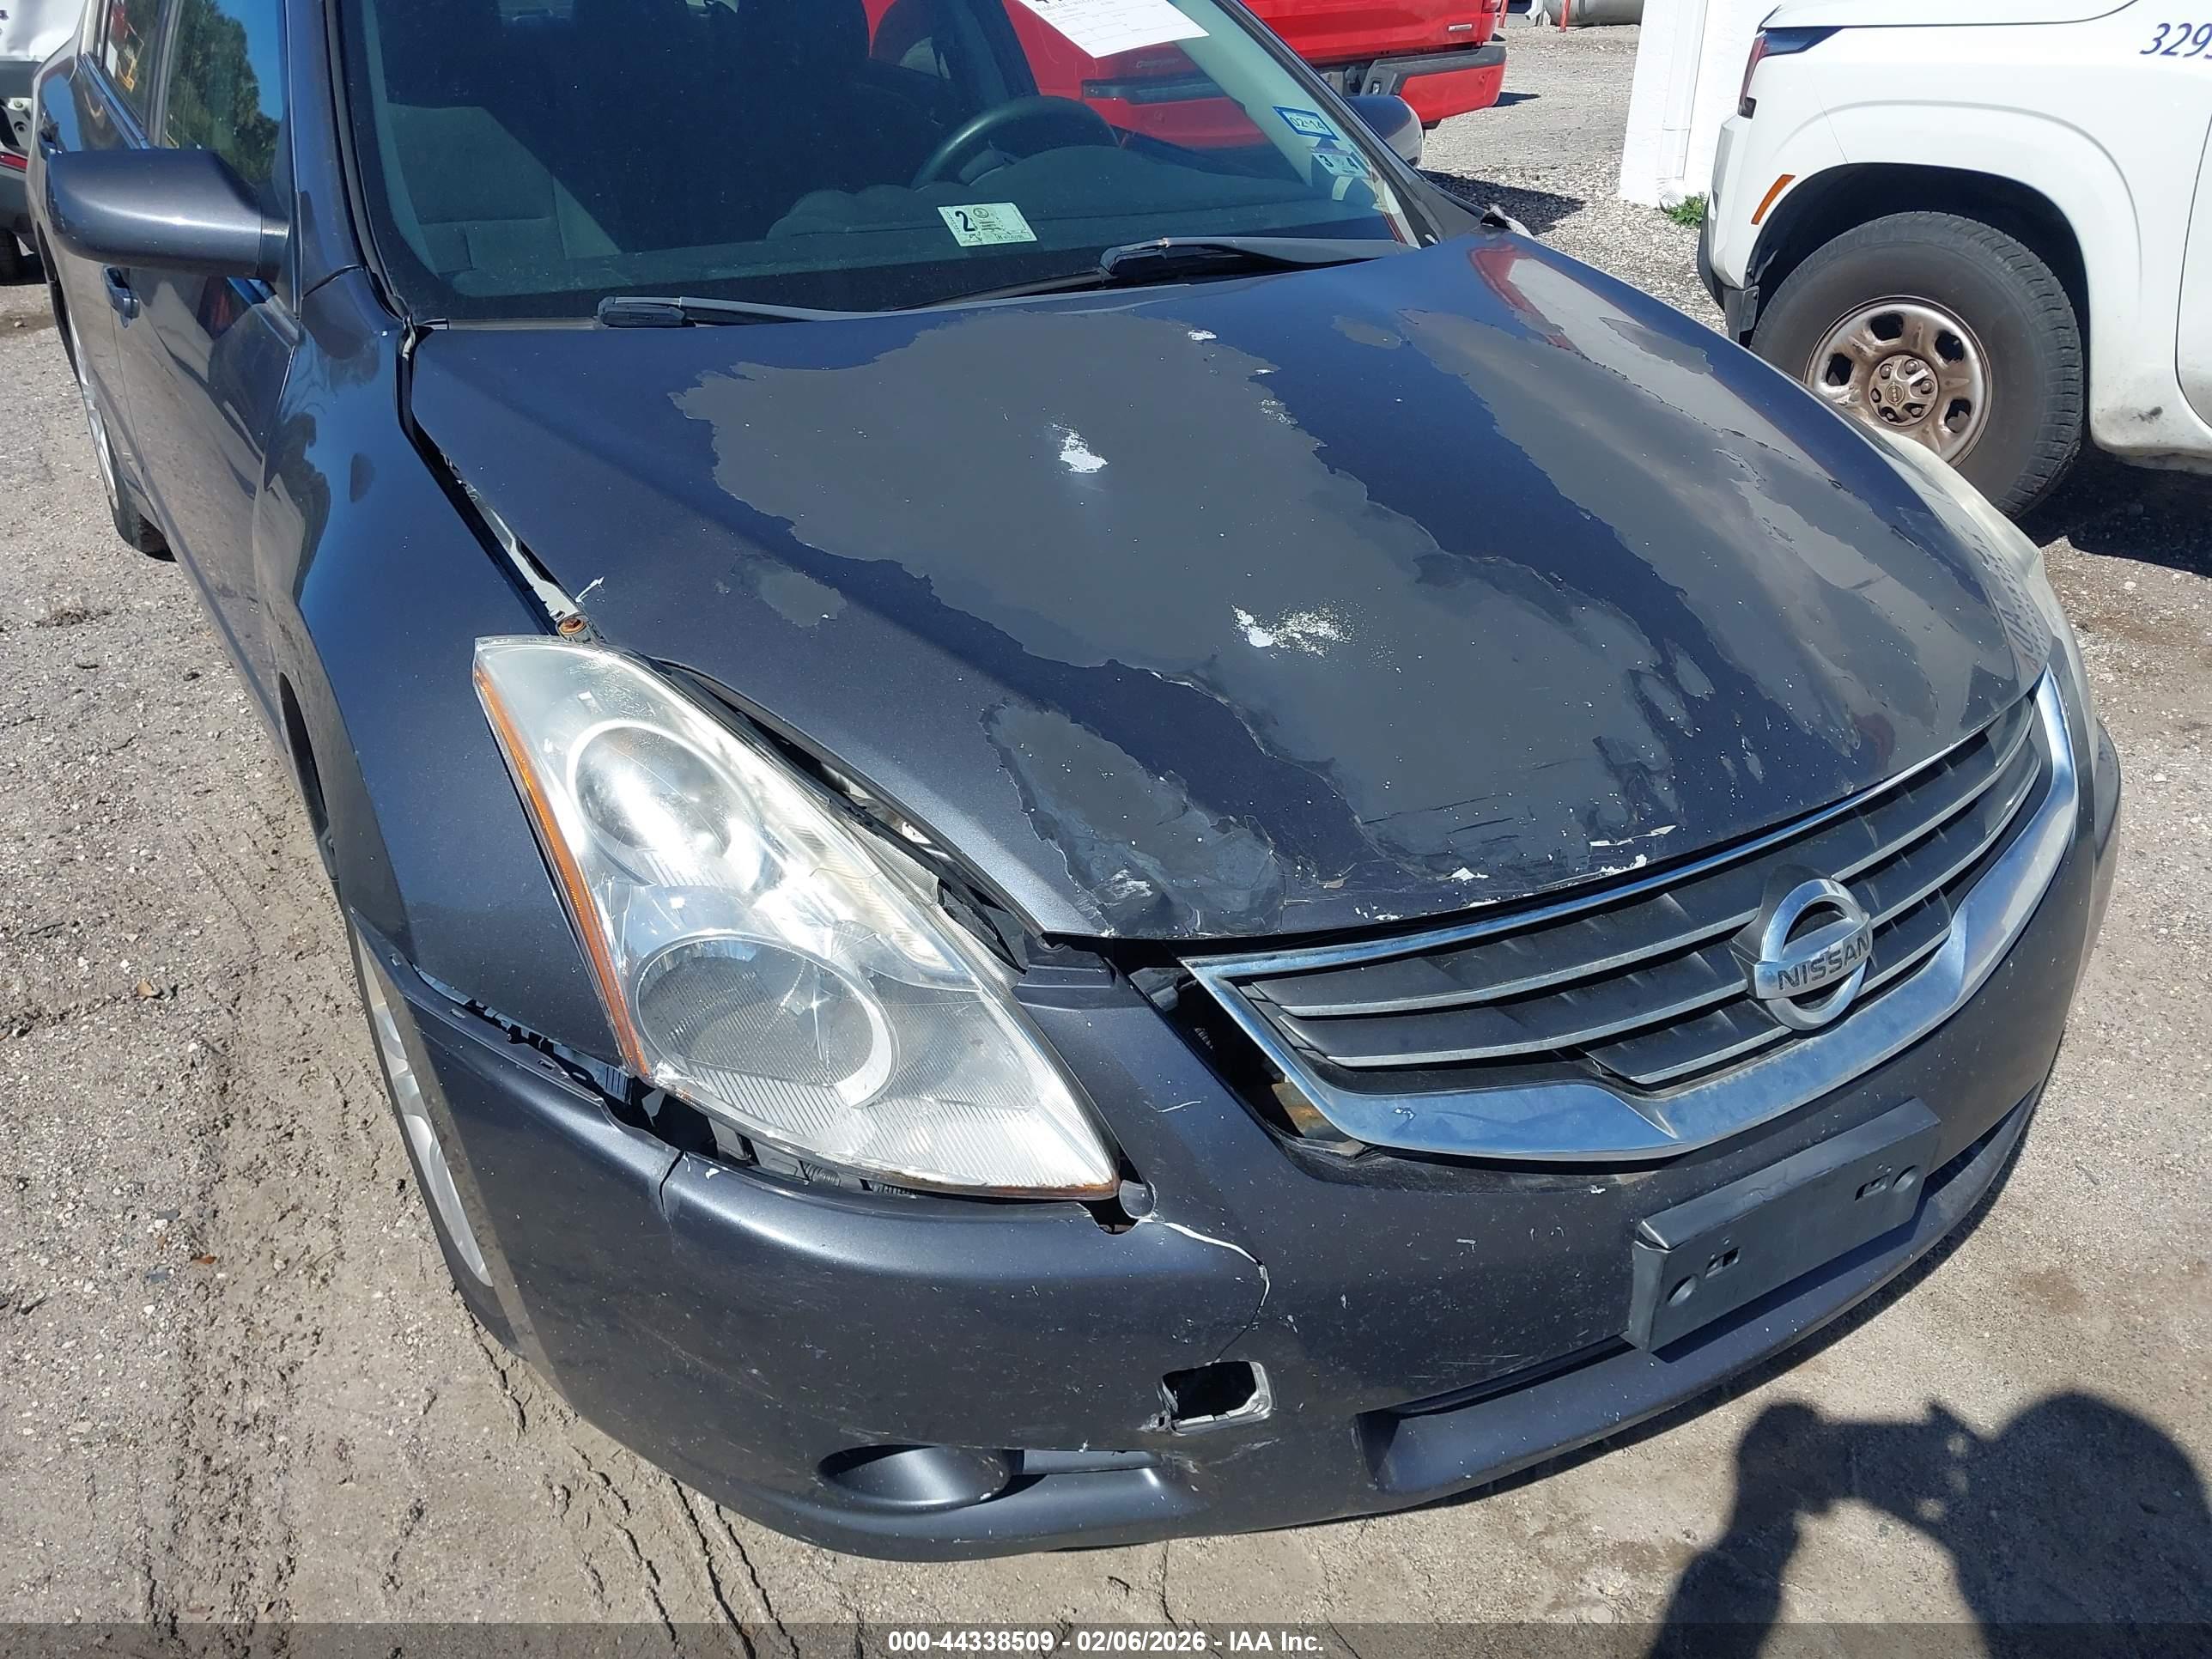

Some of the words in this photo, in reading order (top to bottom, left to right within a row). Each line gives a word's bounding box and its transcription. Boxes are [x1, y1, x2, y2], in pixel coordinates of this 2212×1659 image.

[2139, 22, 2212, 59] 329
[954, 210, 976, 233] 2
[1777, 933, 1869, 990] NISSAN
